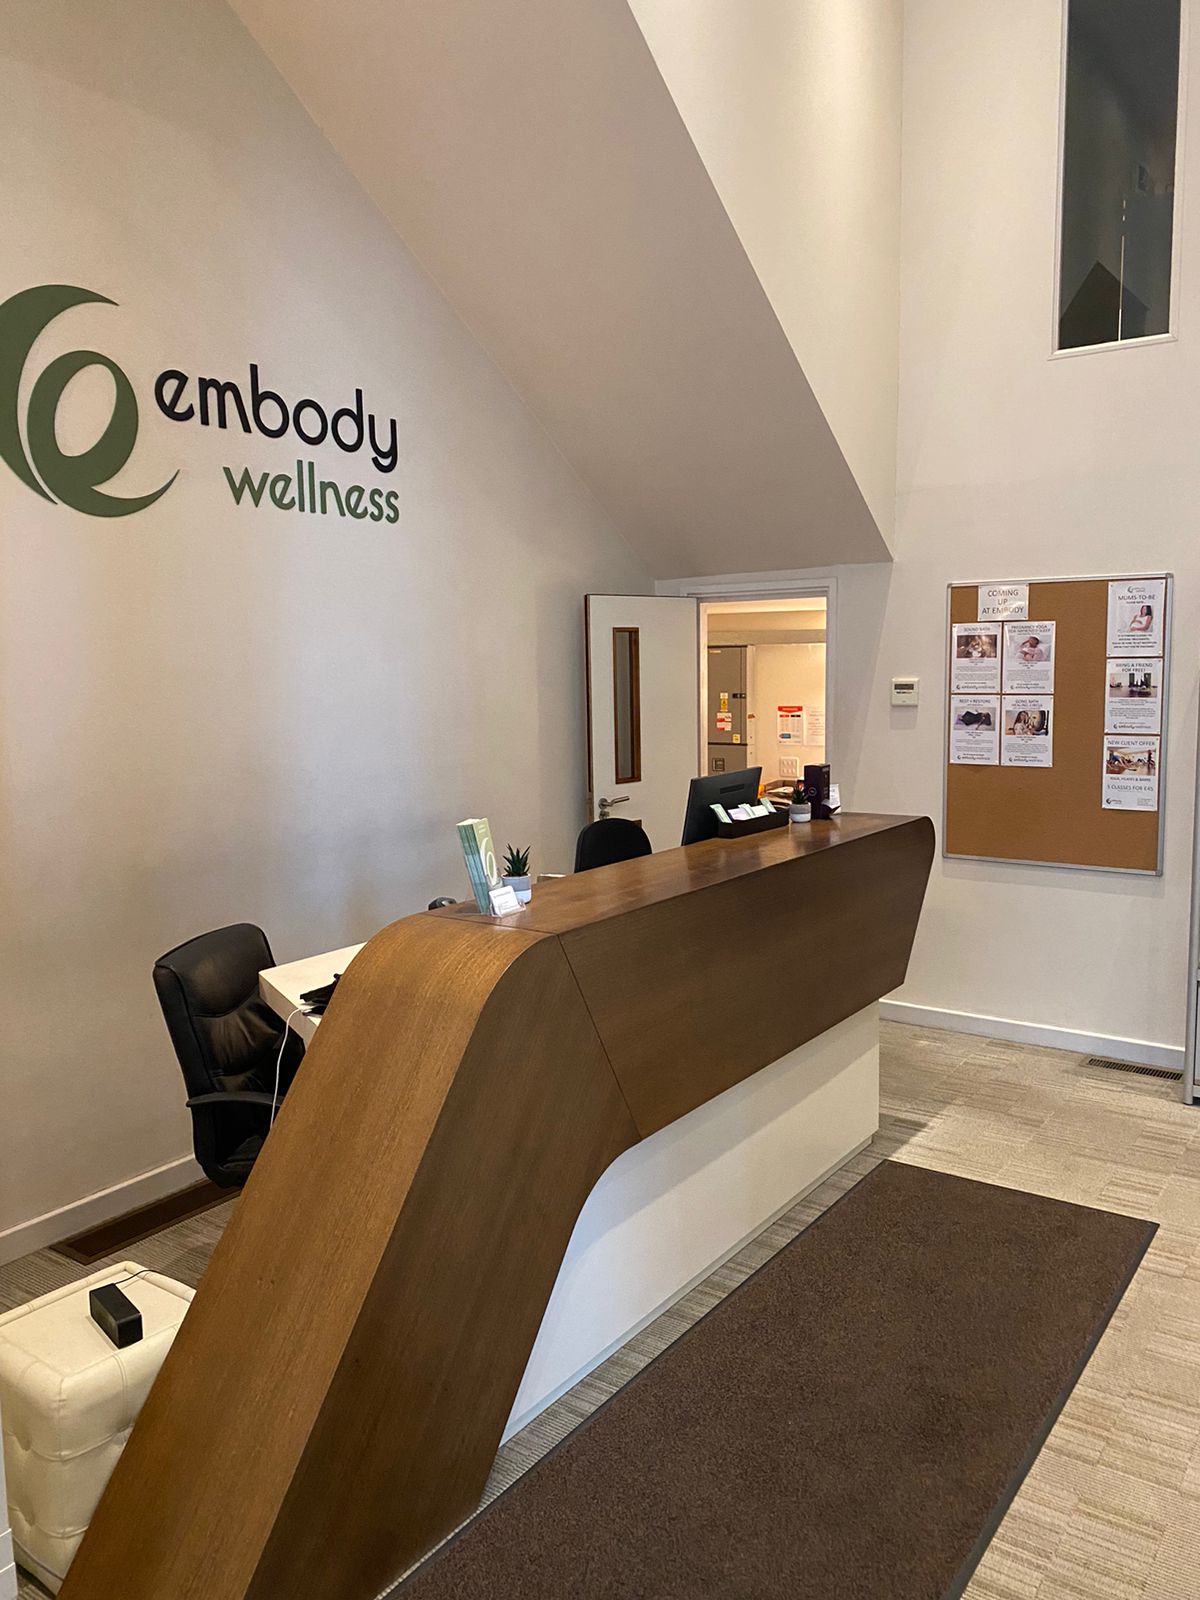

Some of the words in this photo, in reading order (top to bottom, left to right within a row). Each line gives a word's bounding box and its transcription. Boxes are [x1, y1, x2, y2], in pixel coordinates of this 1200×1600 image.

[154, 363, 398, 473] embody
[222, 458, 400, 523] wellness
[987, 589, 1019, 597] COMING
[997, 598, 1009, 606] UP
[981, 607, 991, 615] AT
[992, 606, 1024, 614] EMBODY
